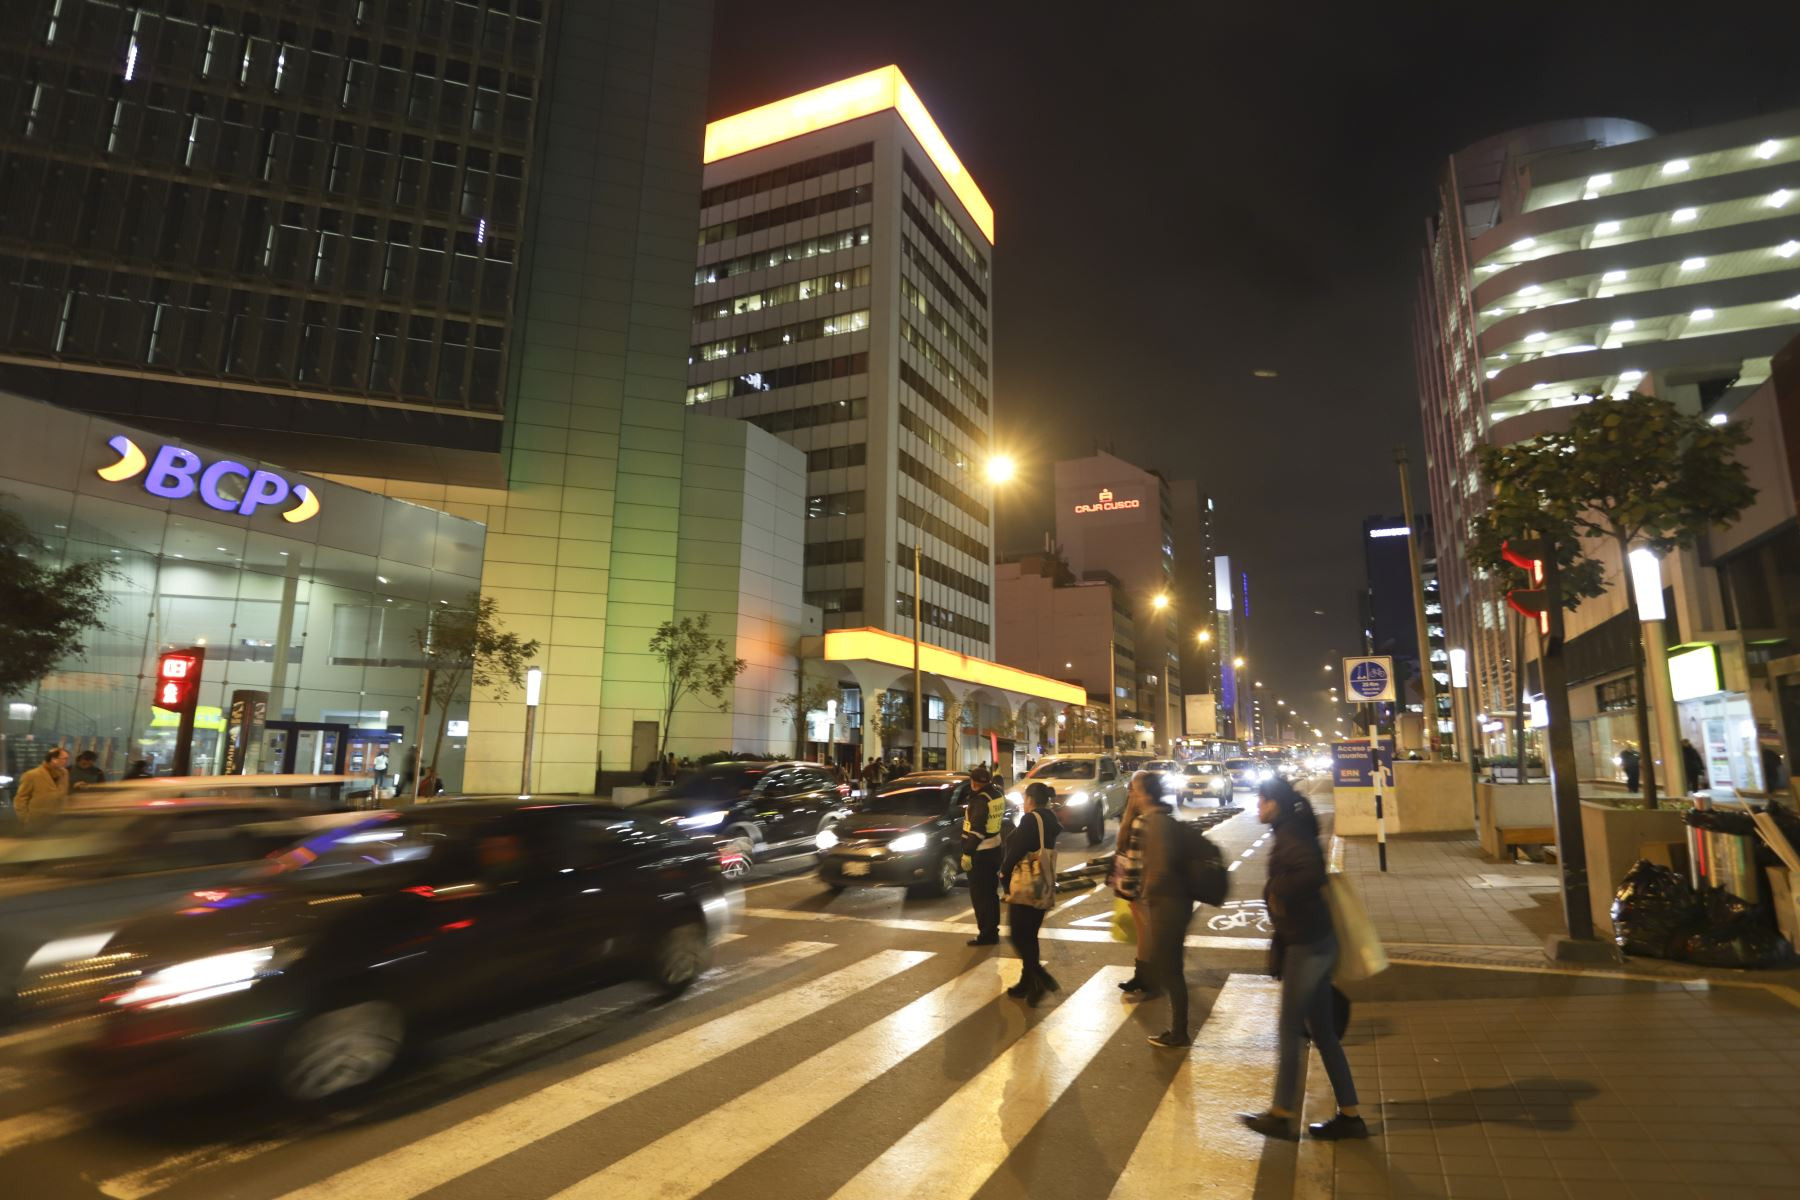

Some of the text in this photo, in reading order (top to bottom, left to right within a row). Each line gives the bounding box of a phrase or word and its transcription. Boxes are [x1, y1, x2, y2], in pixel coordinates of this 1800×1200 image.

[145, 444, 290, 516] BCP
[1075, 500, 1140, 513] CAJA CUSCO
